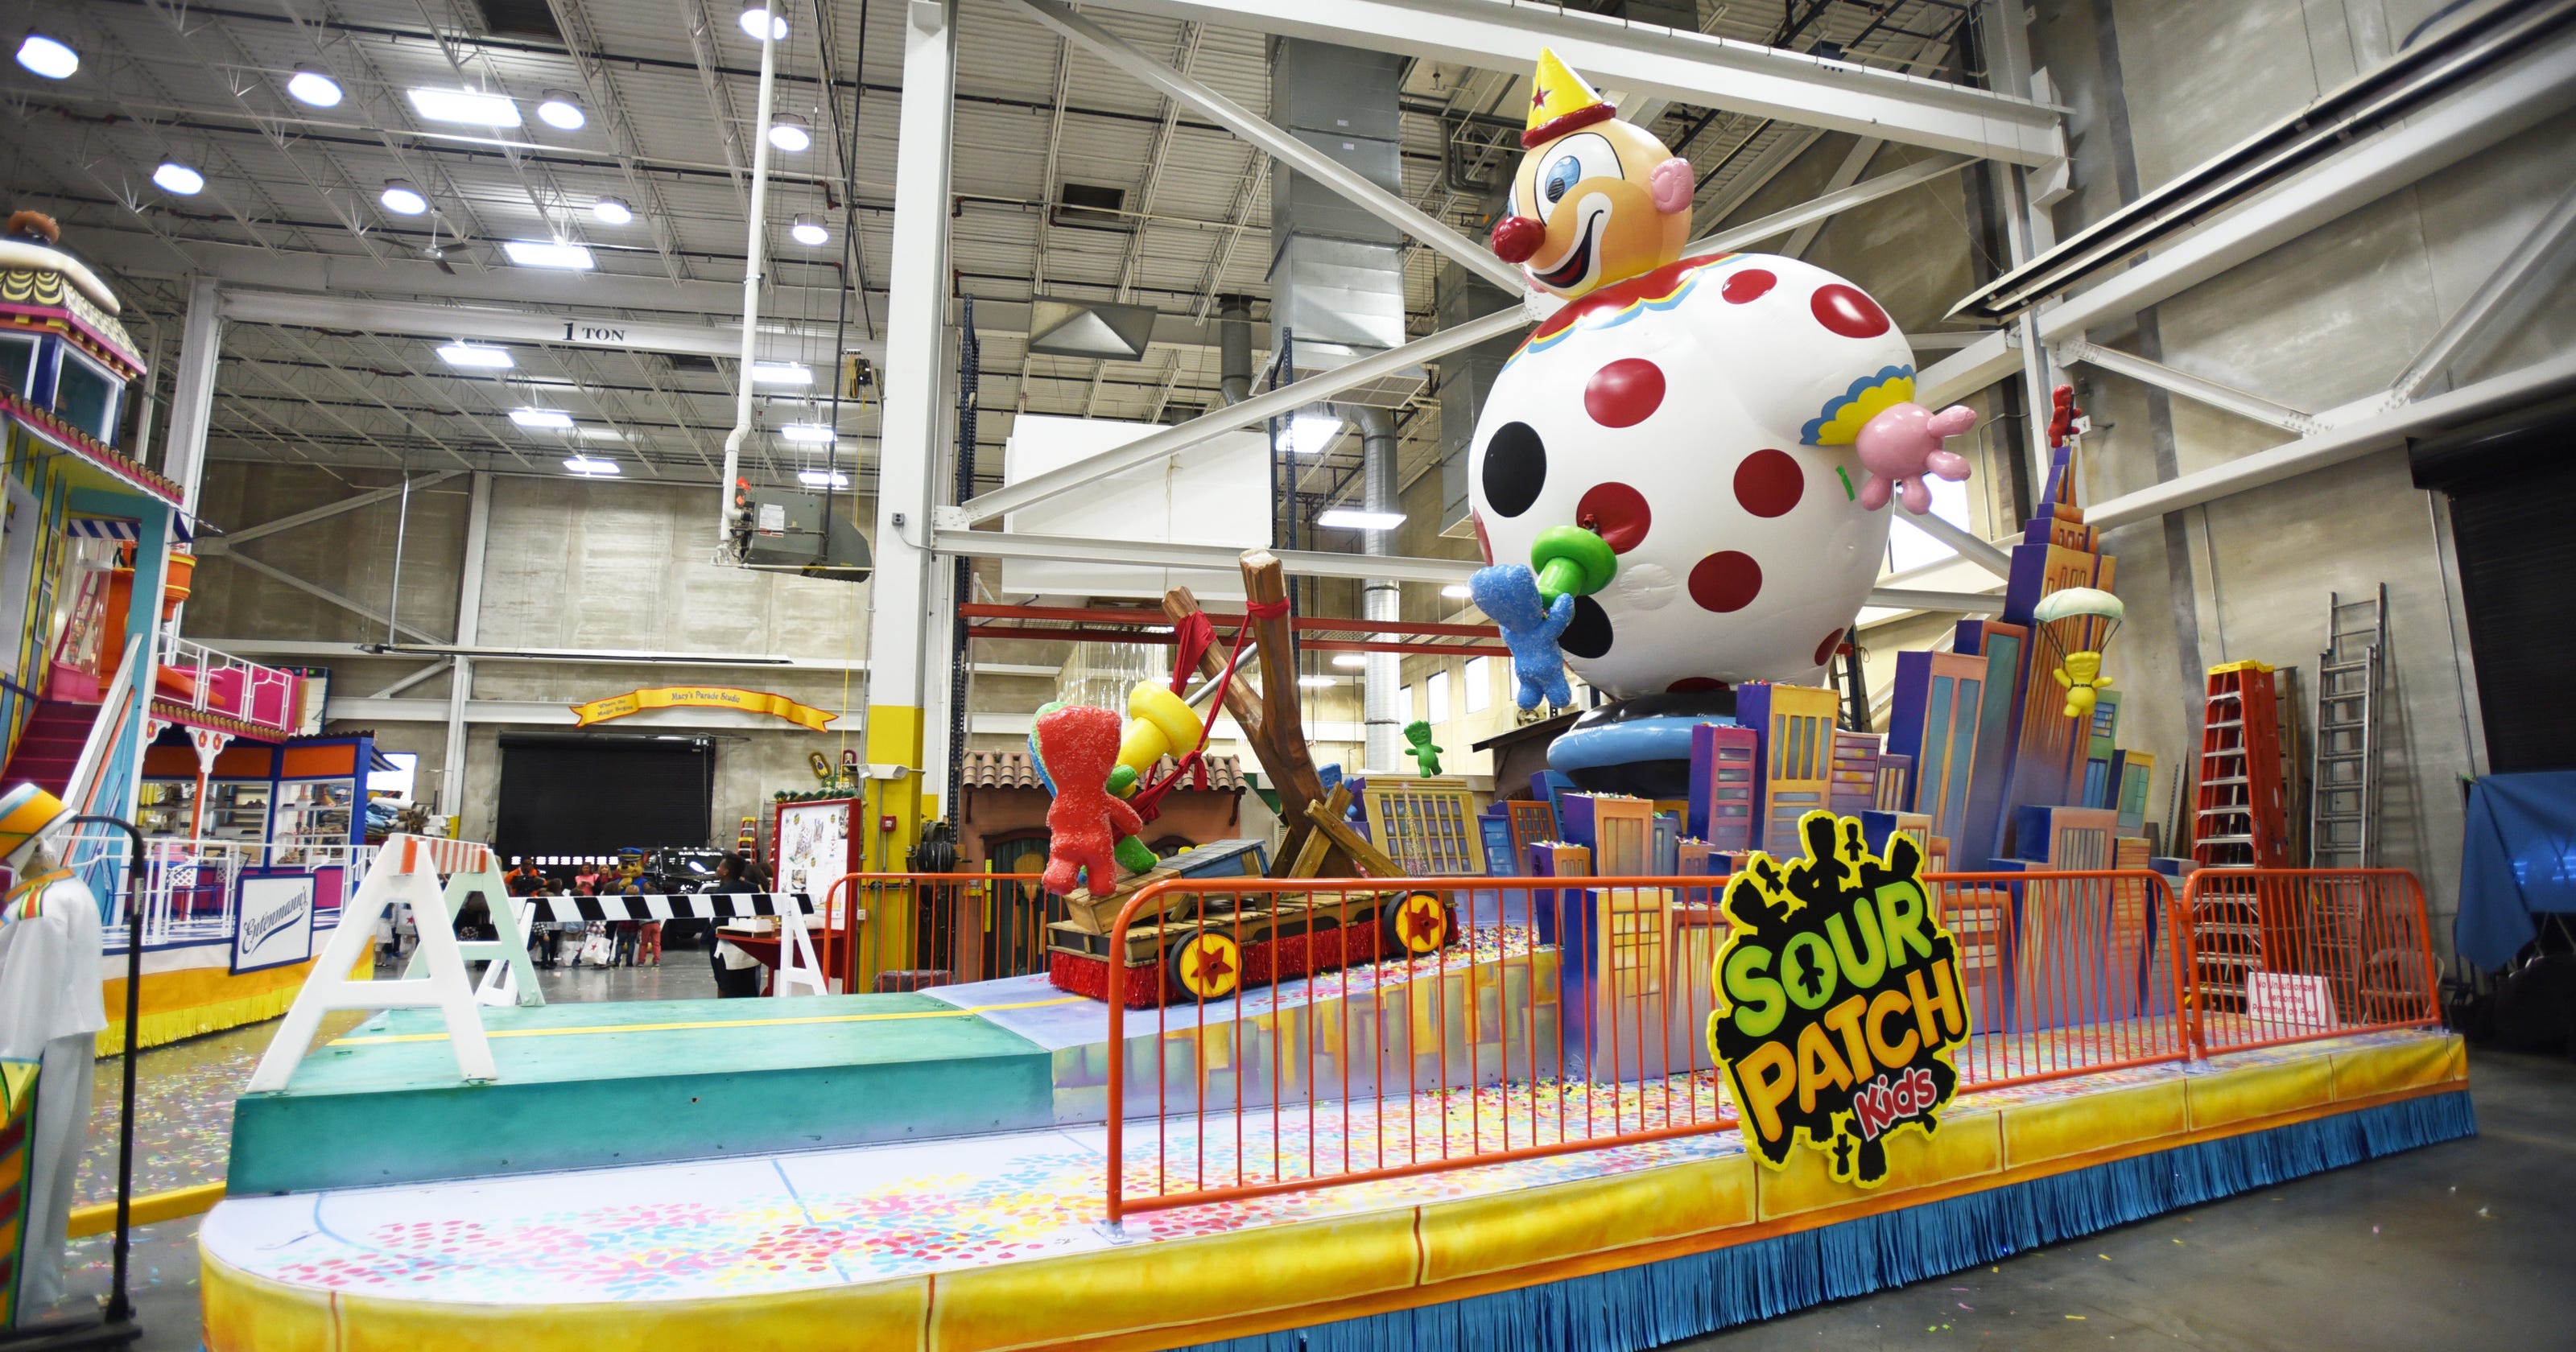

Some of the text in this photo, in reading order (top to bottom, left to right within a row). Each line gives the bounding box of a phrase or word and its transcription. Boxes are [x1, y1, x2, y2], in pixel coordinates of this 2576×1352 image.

[562, 322, 625, 342] 1 TON
[671, 690, 741, 703] Macy's Parade Studio
[242, 886, 308, 954] Entenmann's
[1726, 880, 1932, 1037] SOUR
[1735, 958, 1963, 1143] PATCH
[1854, 1066, 1937, 1143] Kids
